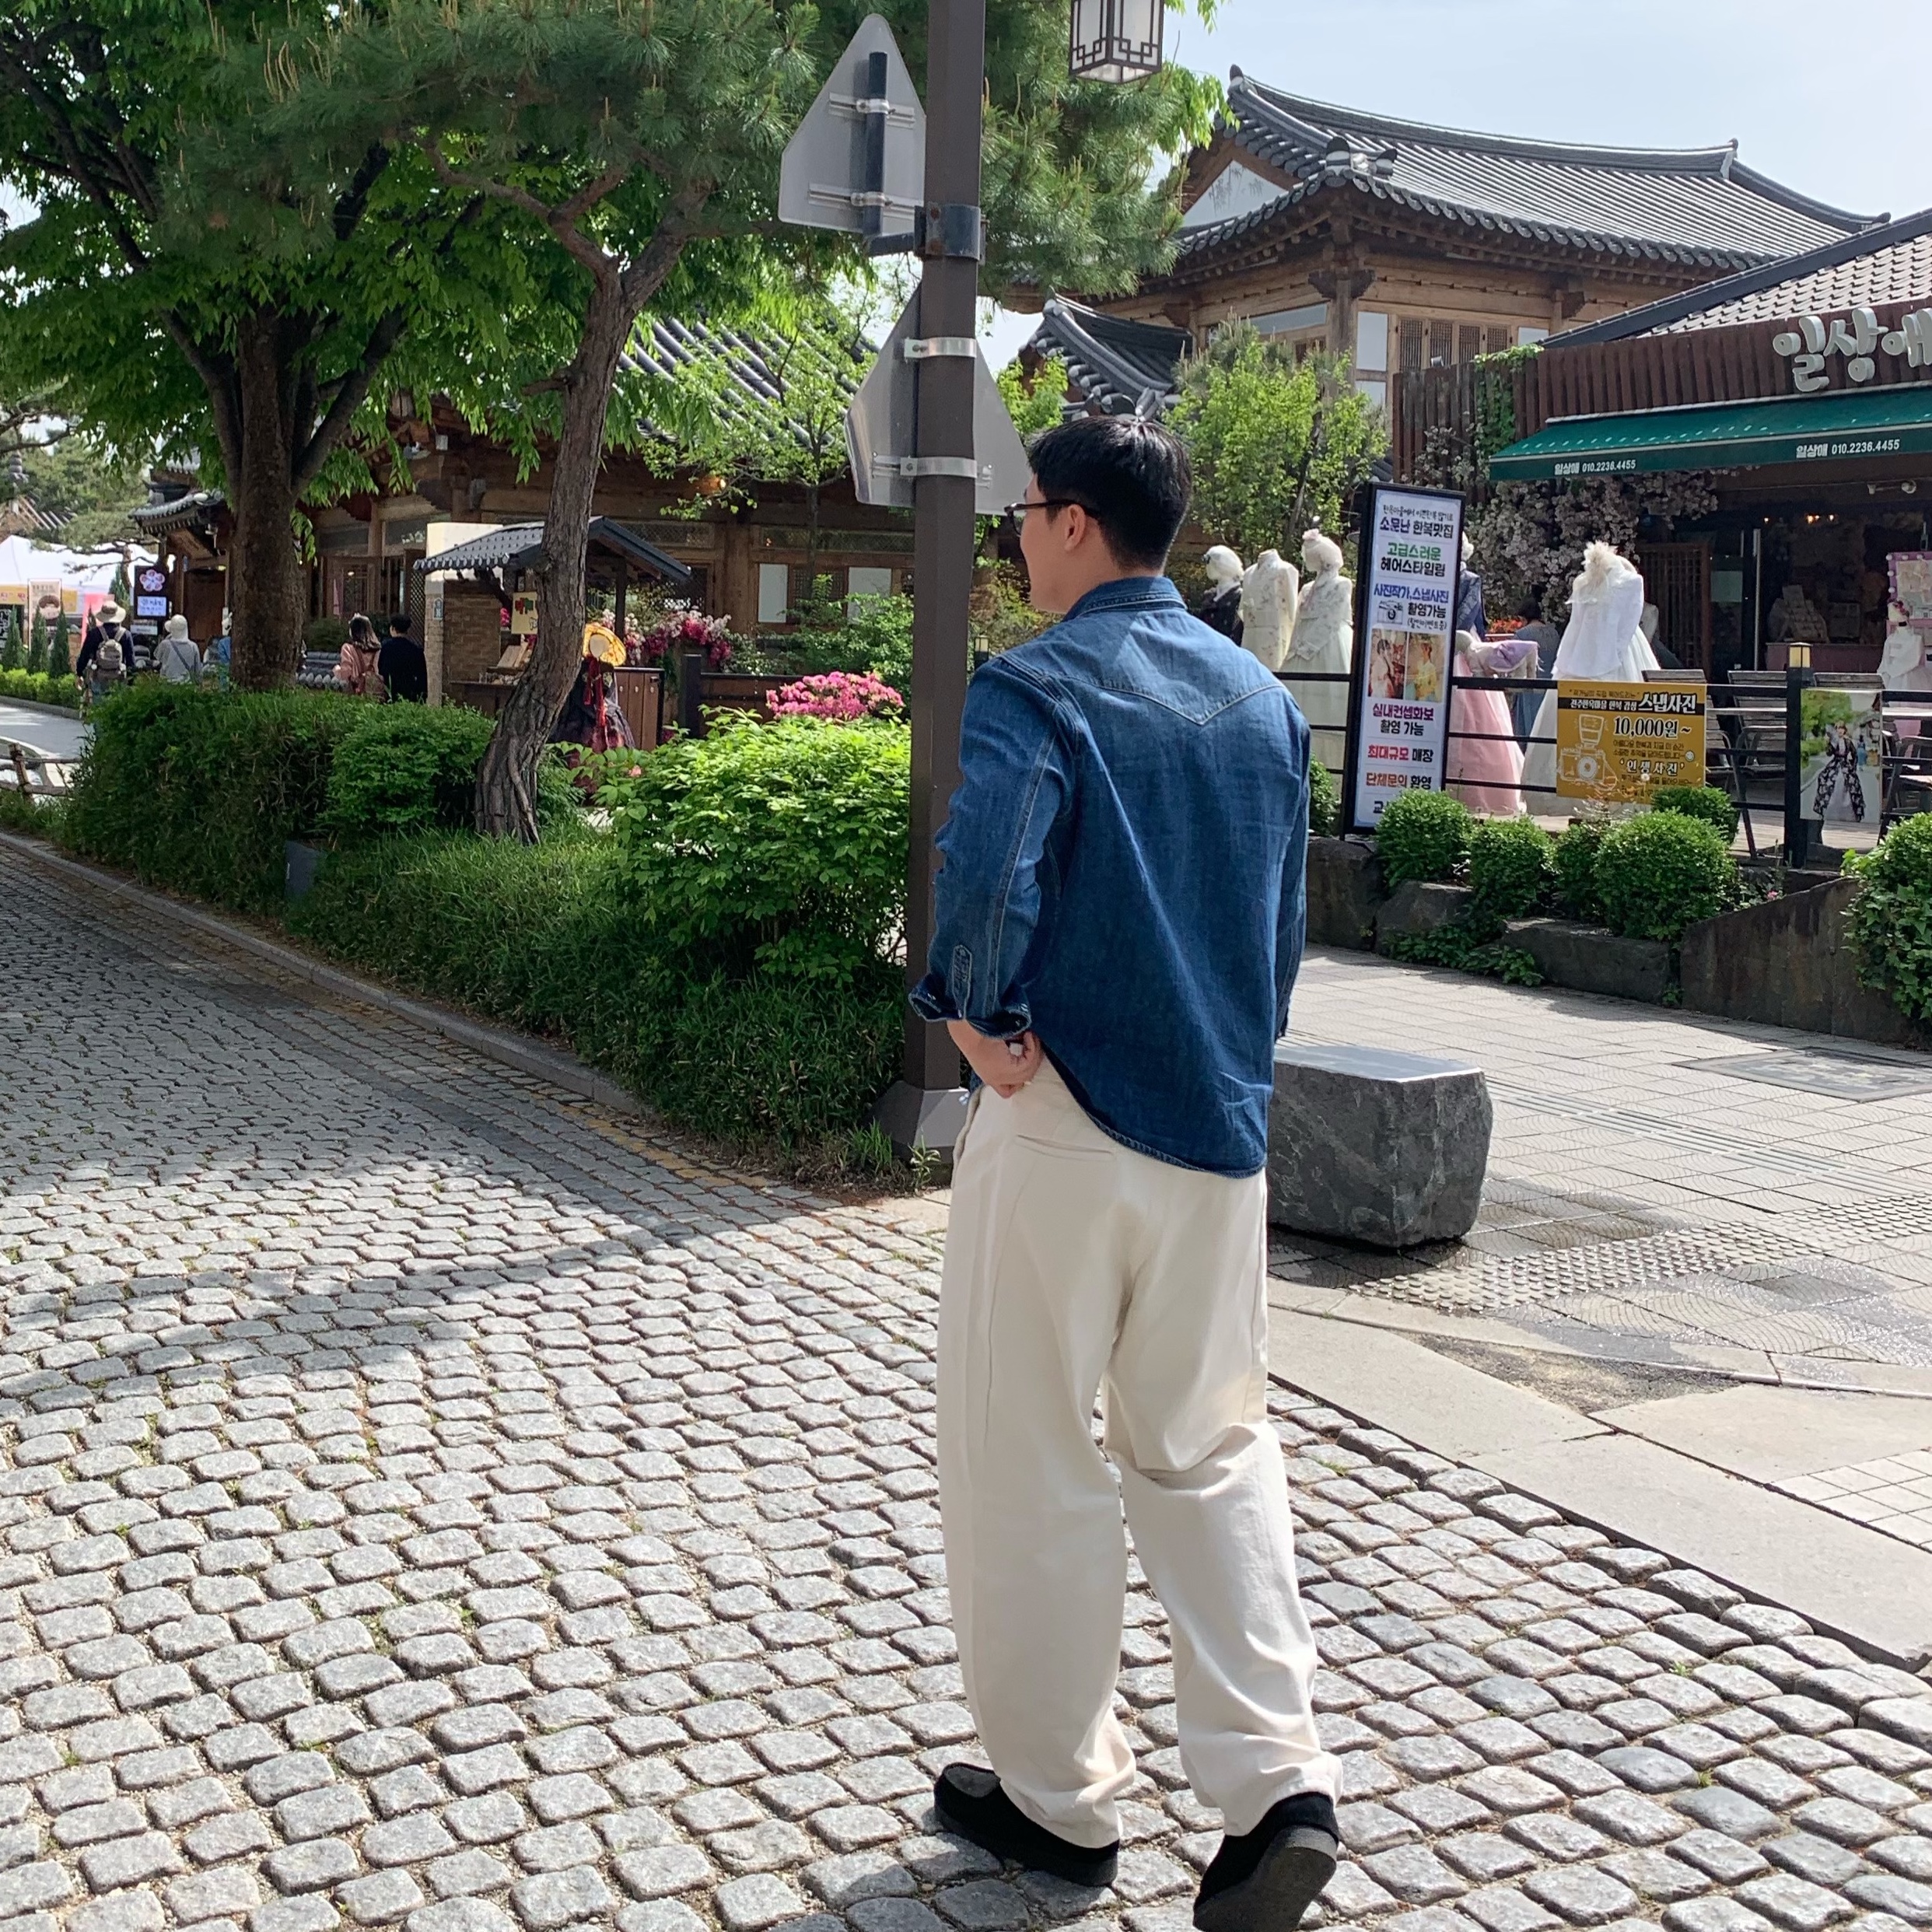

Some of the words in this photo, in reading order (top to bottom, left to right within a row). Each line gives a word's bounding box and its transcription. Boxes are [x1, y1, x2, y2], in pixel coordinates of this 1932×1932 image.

[1796, 443, 1829, 459] 일상애
[1832, 439, 1900, 454] 010.2236.4455
[1554, 461, 1580, 475] 일상애
[1380, 516, 1411, 534] 소문난
[1412, 520, 1454, 539] 한복맛집
[1387, 542, 1441, 561] 고급스러운
[1381, 556, 1446, 577] 헤어스타일링
[1373, 703, 1433, 721] 실내컨셉화보
[1608, 700, 1622, 711] 한복
[1637, 691, 1696, 714] 스냅사진
[1380, 719, 1401, 734] 촬영
[1403, 722, 1424, 737] 가능
[1367, 744, 1409, 761] 최대규모
[1412, 747, 1434, 763] 매장
[1366, 772, 1408, 788] 단체문의
[1410, 775, 1432, 790] 환영
